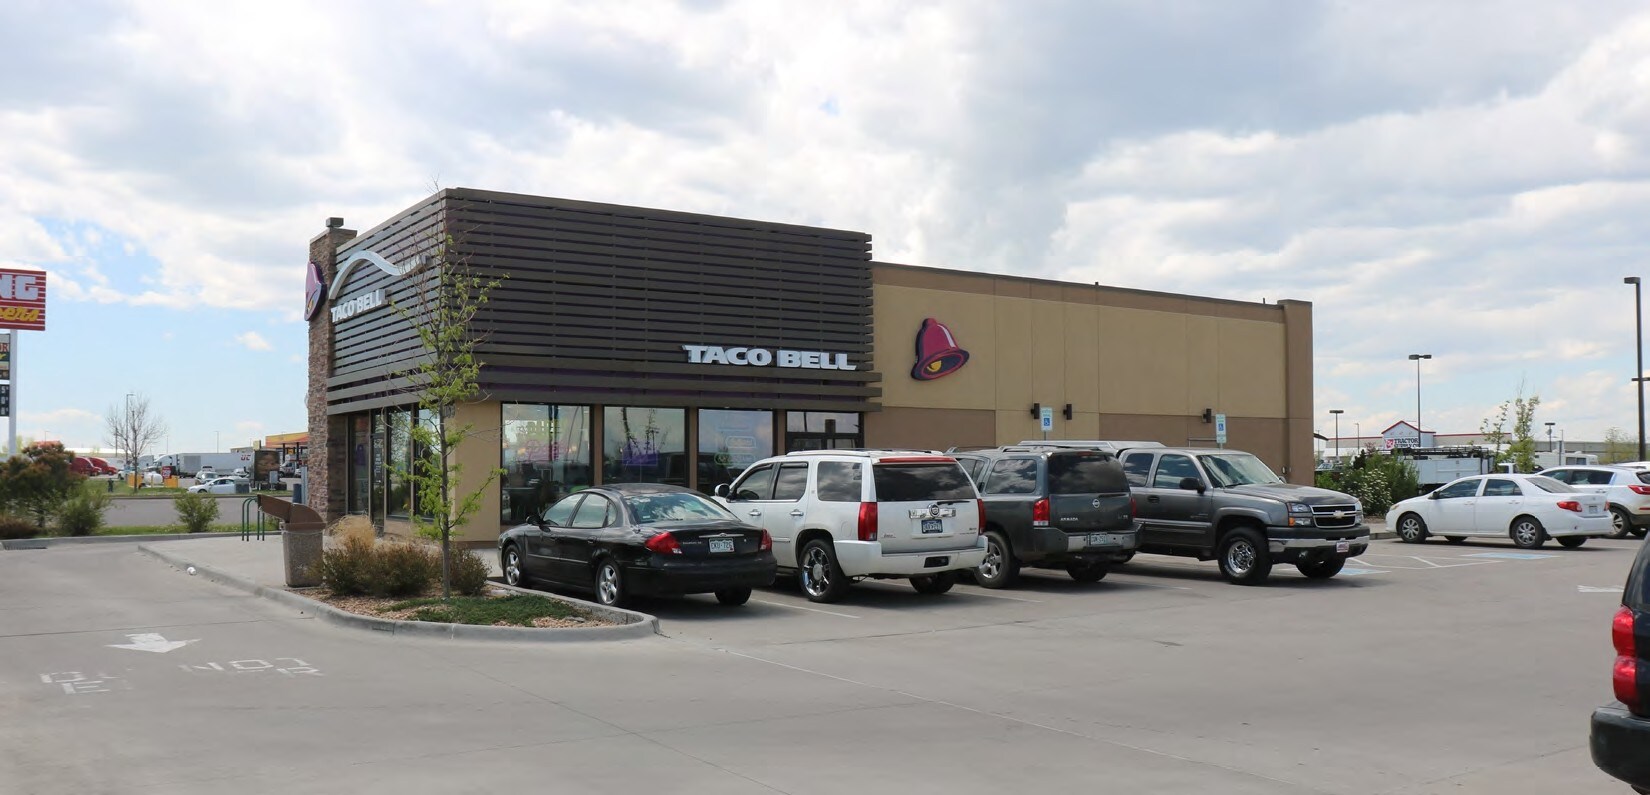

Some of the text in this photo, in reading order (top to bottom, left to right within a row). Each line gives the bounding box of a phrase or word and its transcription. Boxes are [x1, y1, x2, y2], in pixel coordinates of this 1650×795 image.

[331, 289, 385, 323] TACO BELL
[682, 344, 857, 371] TACO BELL
